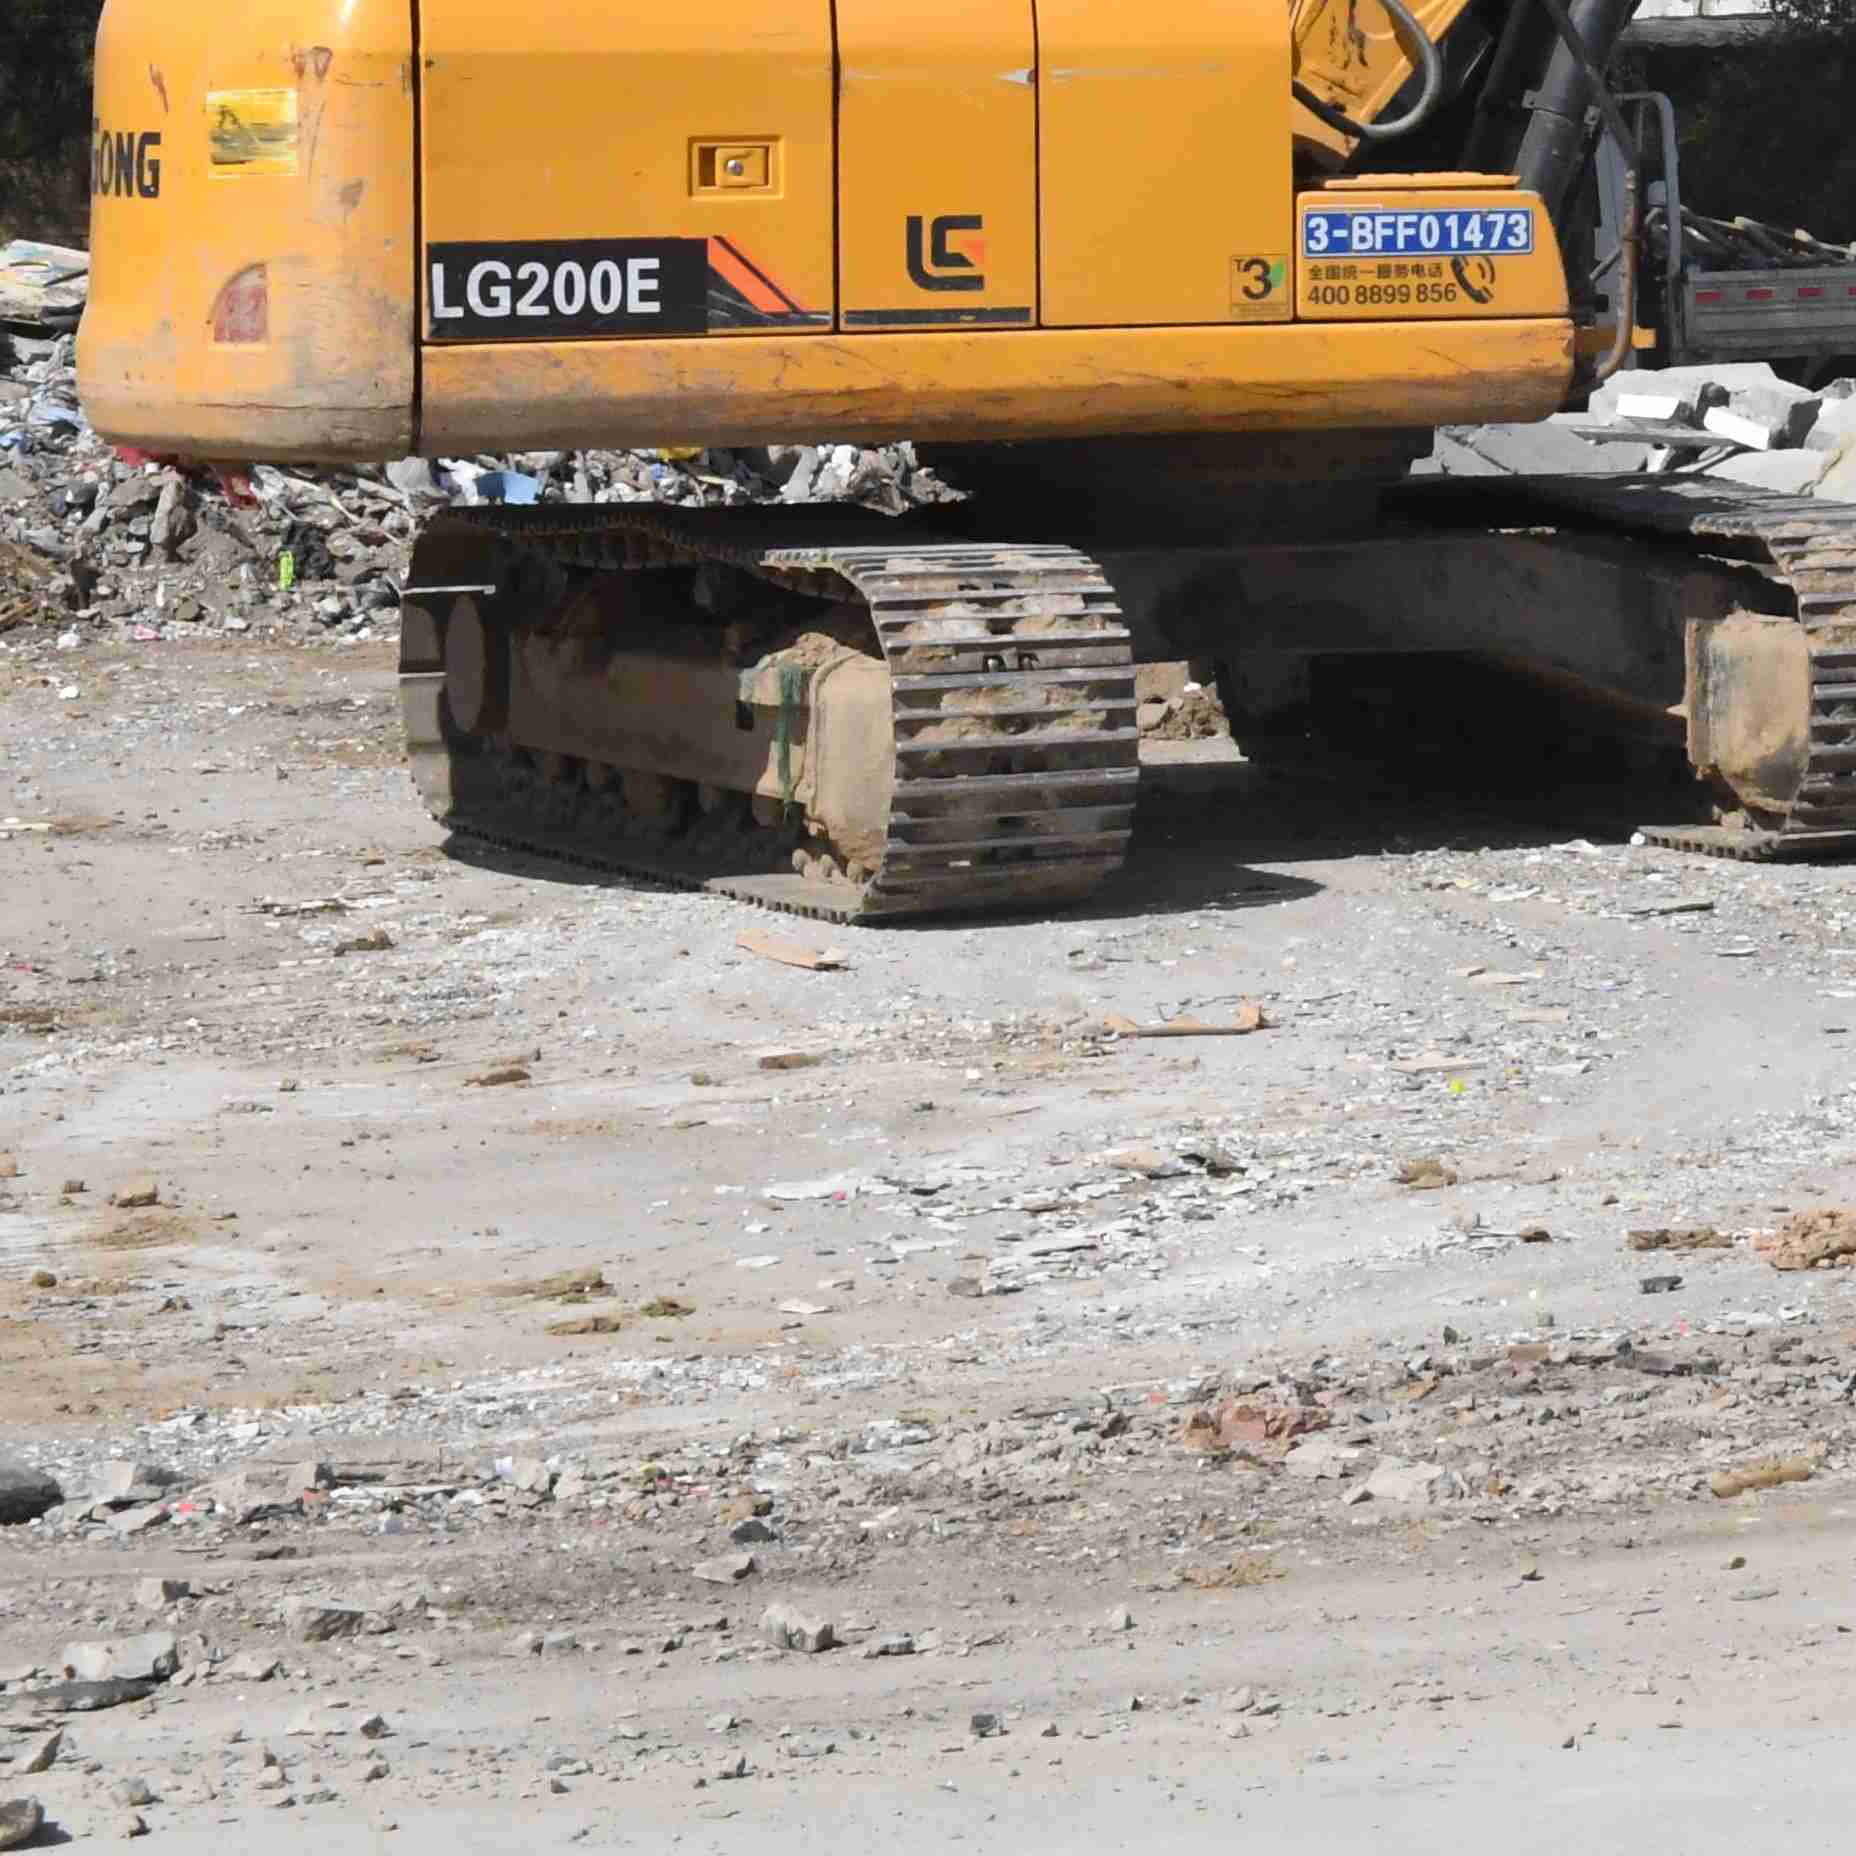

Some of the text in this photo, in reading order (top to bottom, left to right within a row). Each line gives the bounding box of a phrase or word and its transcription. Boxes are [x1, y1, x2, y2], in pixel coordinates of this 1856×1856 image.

[92, 130, 161, 199] ONG
[1307, 212, 1529, 251] 3-BFF01473
[430, 257, 662, 319] LG200E
[1308, 262, 1444, 281] 全国统一服务电话
[1308, 282, 1457, 306] 400 8899 856
